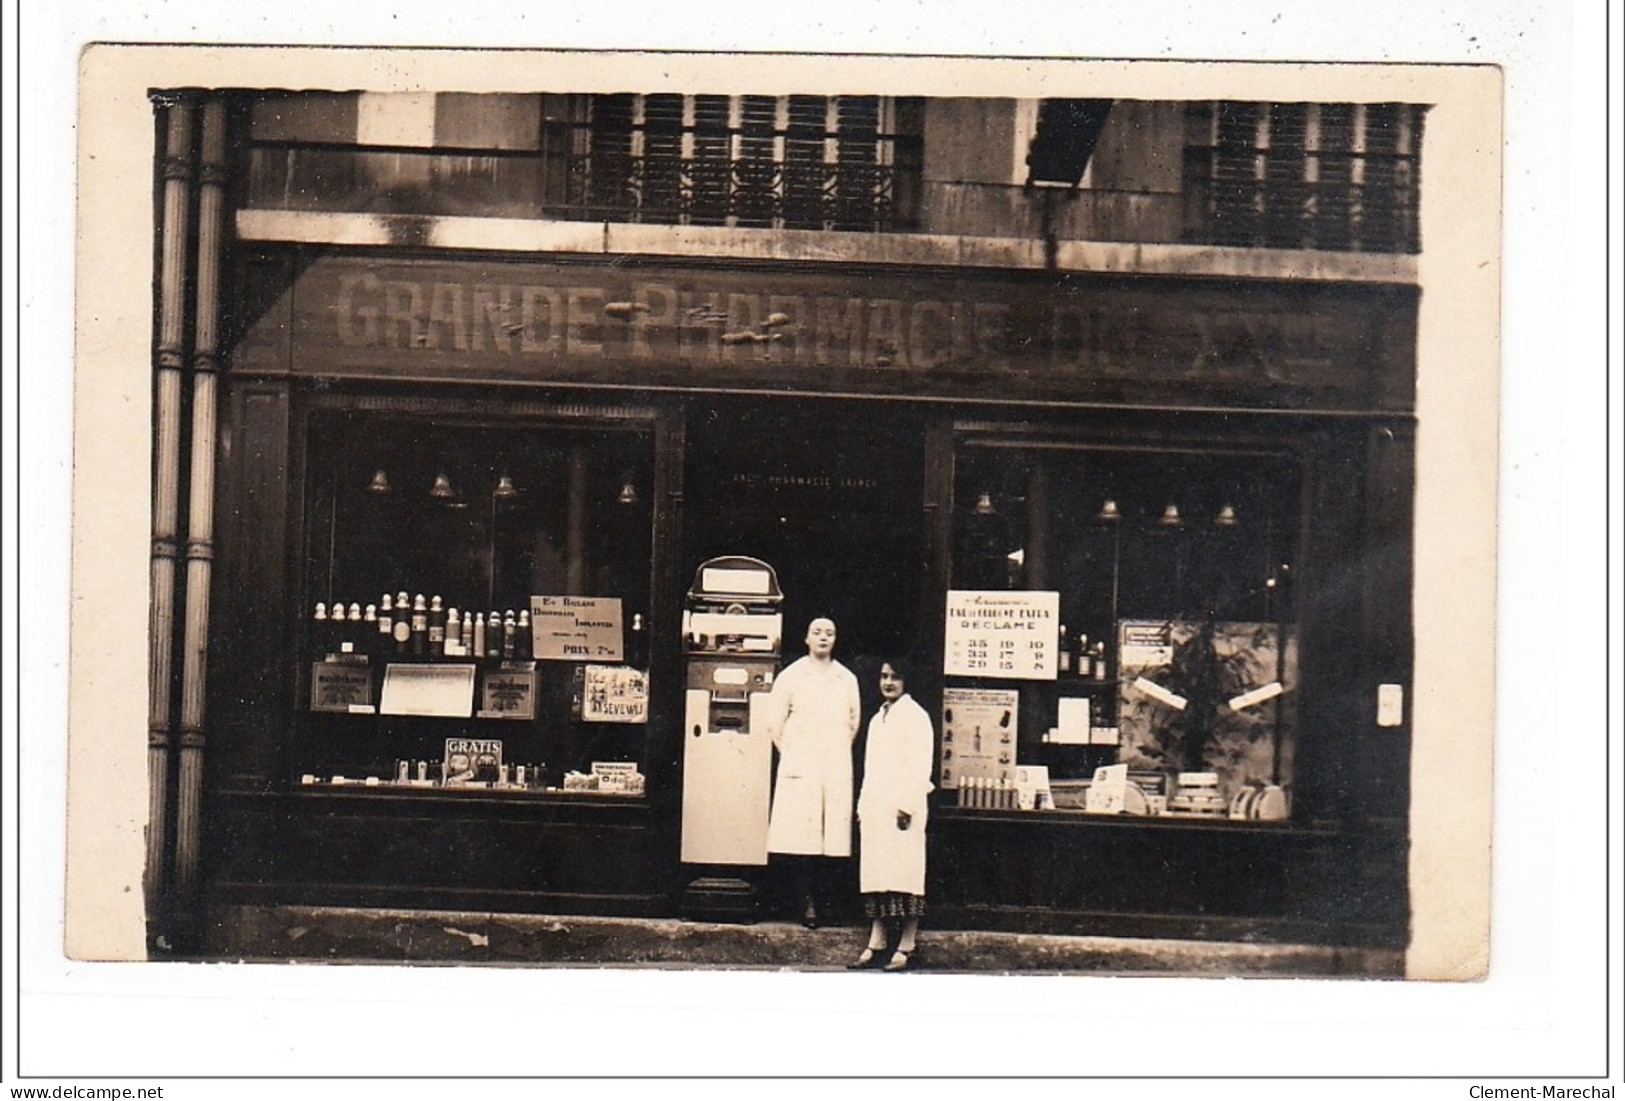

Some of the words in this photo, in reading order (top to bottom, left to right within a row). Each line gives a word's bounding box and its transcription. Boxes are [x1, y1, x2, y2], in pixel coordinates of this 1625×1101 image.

[337, 272, 603, 354] GRANDE
[634, 283, 1009, 371] PHARMACIE
[563, 645, 591, 655] PRIX
[1029, 640, 1044, 649] 10
[448, 740, 499, 754] GRATIS
